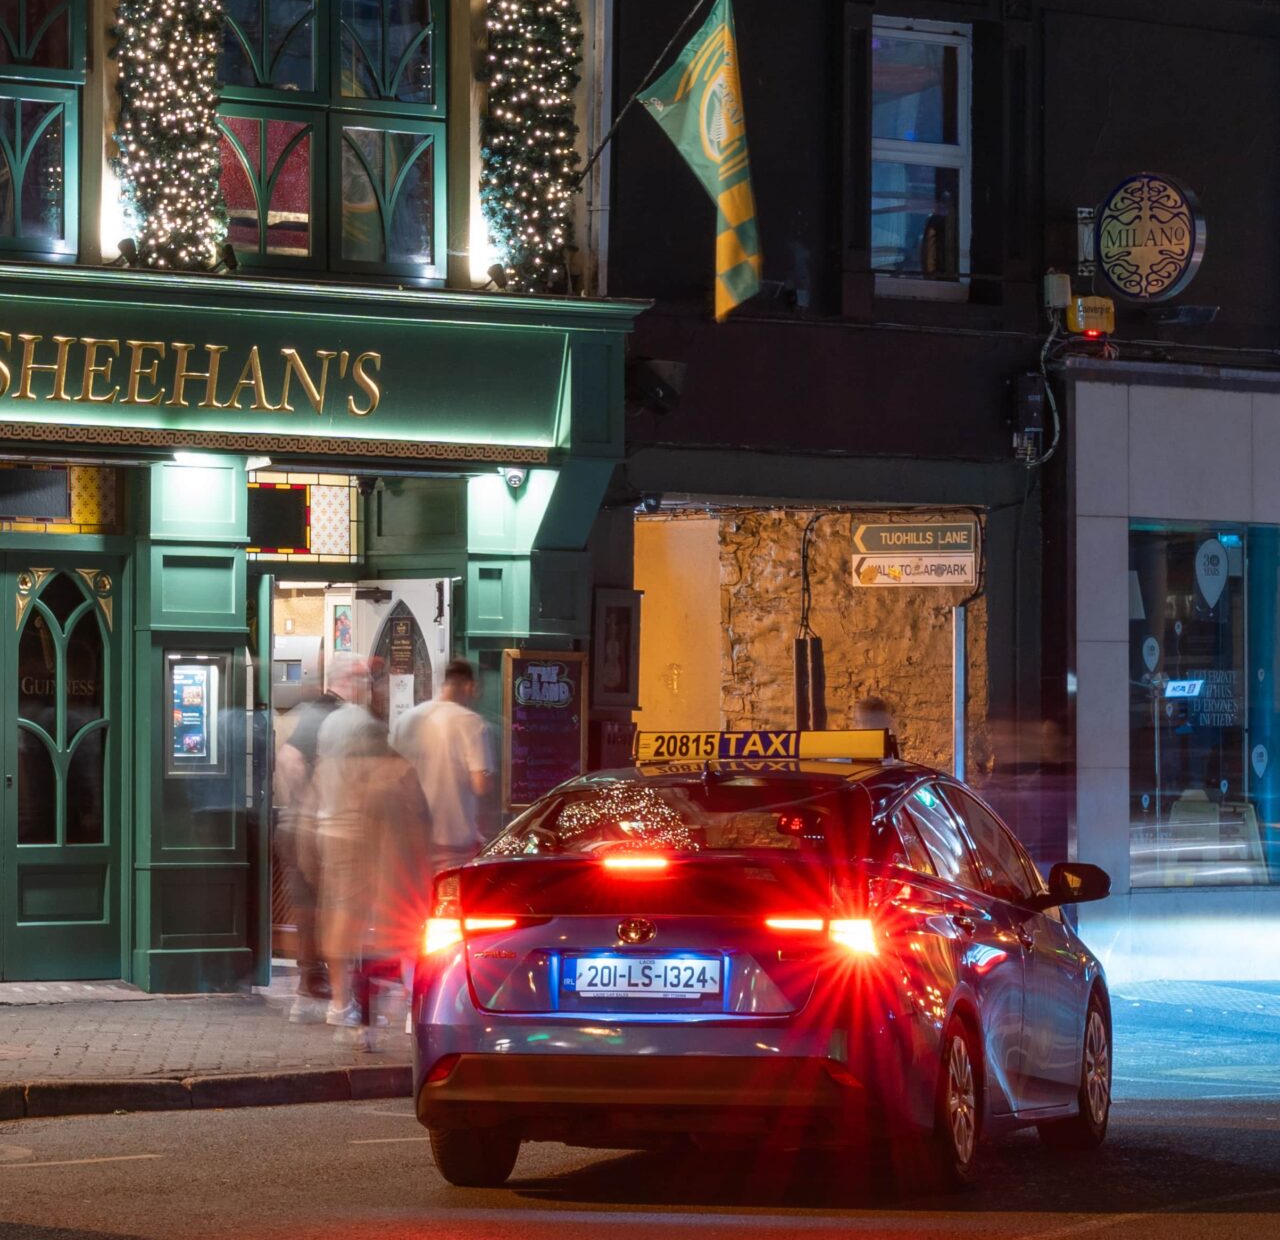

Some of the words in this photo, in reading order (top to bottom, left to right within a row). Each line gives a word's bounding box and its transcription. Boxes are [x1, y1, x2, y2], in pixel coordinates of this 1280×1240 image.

[1105, 226, 1186, 249] MILANO
[880, 531, 934, 545] TUOHILLS
[938, 531, 969, 544] LANE
[899, 564, 912, 576] TO
[653, 734, 716, 758] 20815
[724, 733, 796, 757] TAXI
[563, 977, 575, 986] IRL
[586, 964, 708, 989] 201-LS-1324
